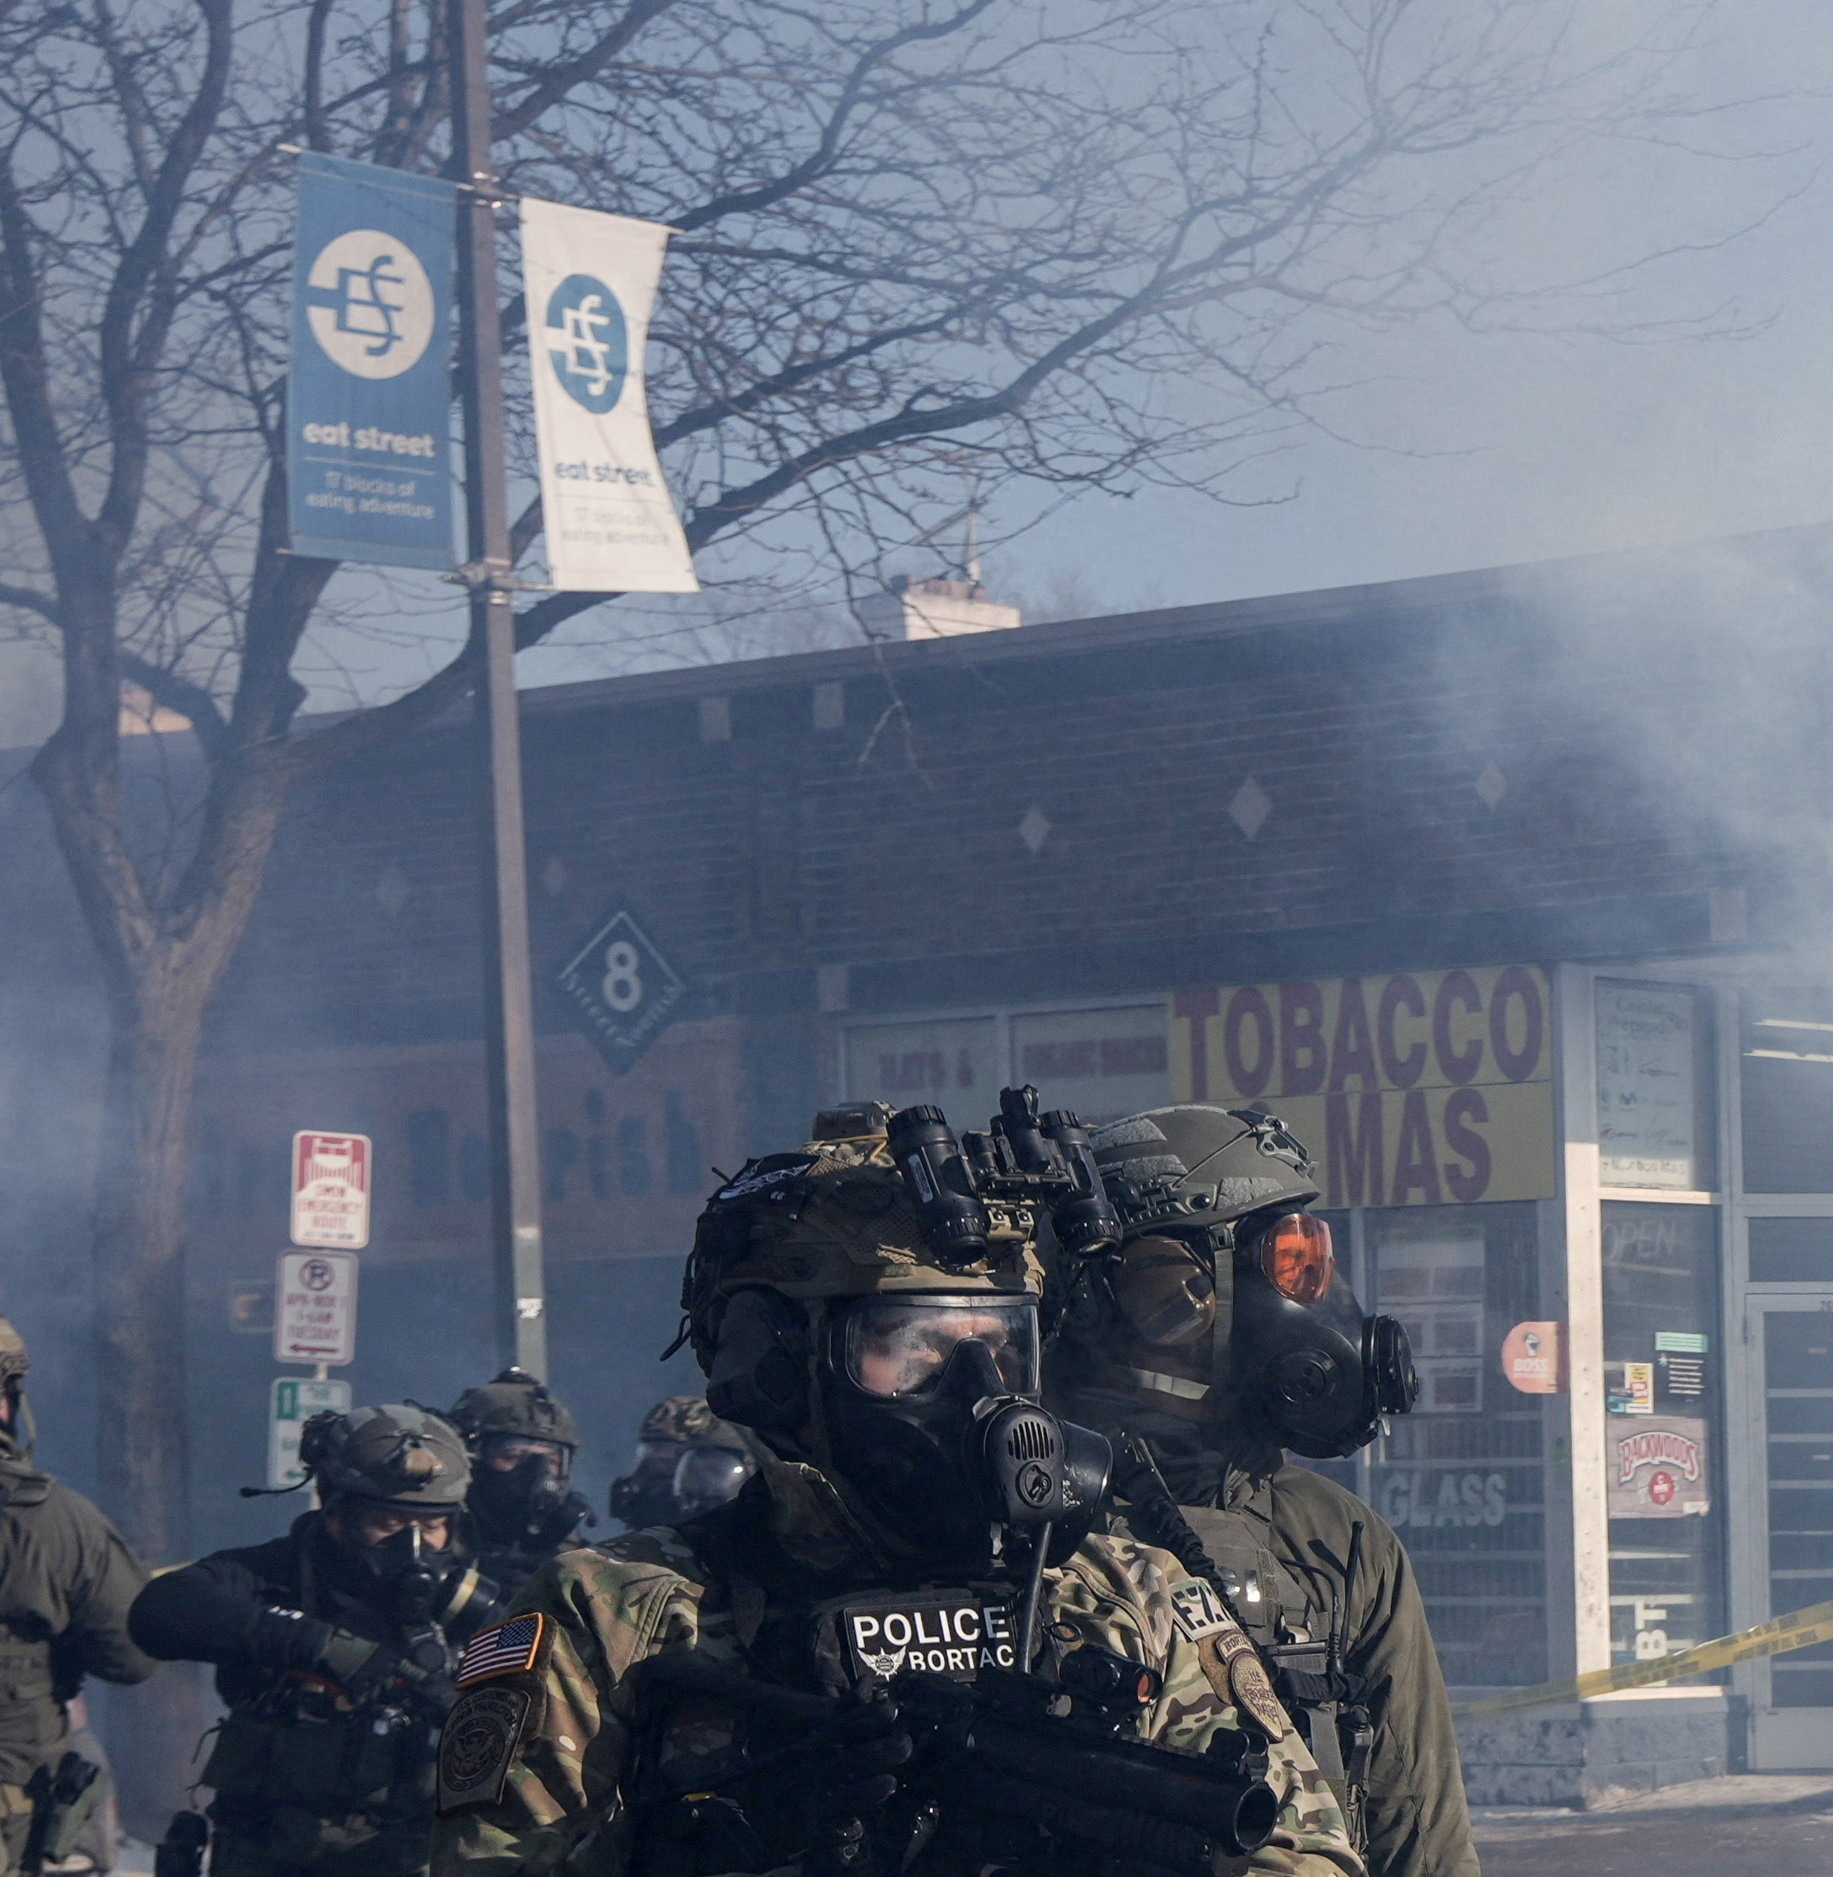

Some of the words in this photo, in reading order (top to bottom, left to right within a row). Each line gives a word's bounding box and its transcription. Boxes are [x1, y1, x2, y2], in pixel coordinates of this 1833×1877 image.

[302, 422, 350, 447] eat
[354, 427, 435, 457] street
[555, 460, 590, 480] eat
[594, 464, 654, 487] street
[603, 941, 642, 1012] 8
[1174, 965, 1543, 1100] TOBACCO
[1325, 1087, 1493, 1207] MAS
[1622, 1433, 1697, 1478] BACKWOODS
[1381, 1474, 1506, 1527] GLASS
[853, 1608, 1010, 1649] POLICE
[908, 1645, 1014, 1672] BORTAC
